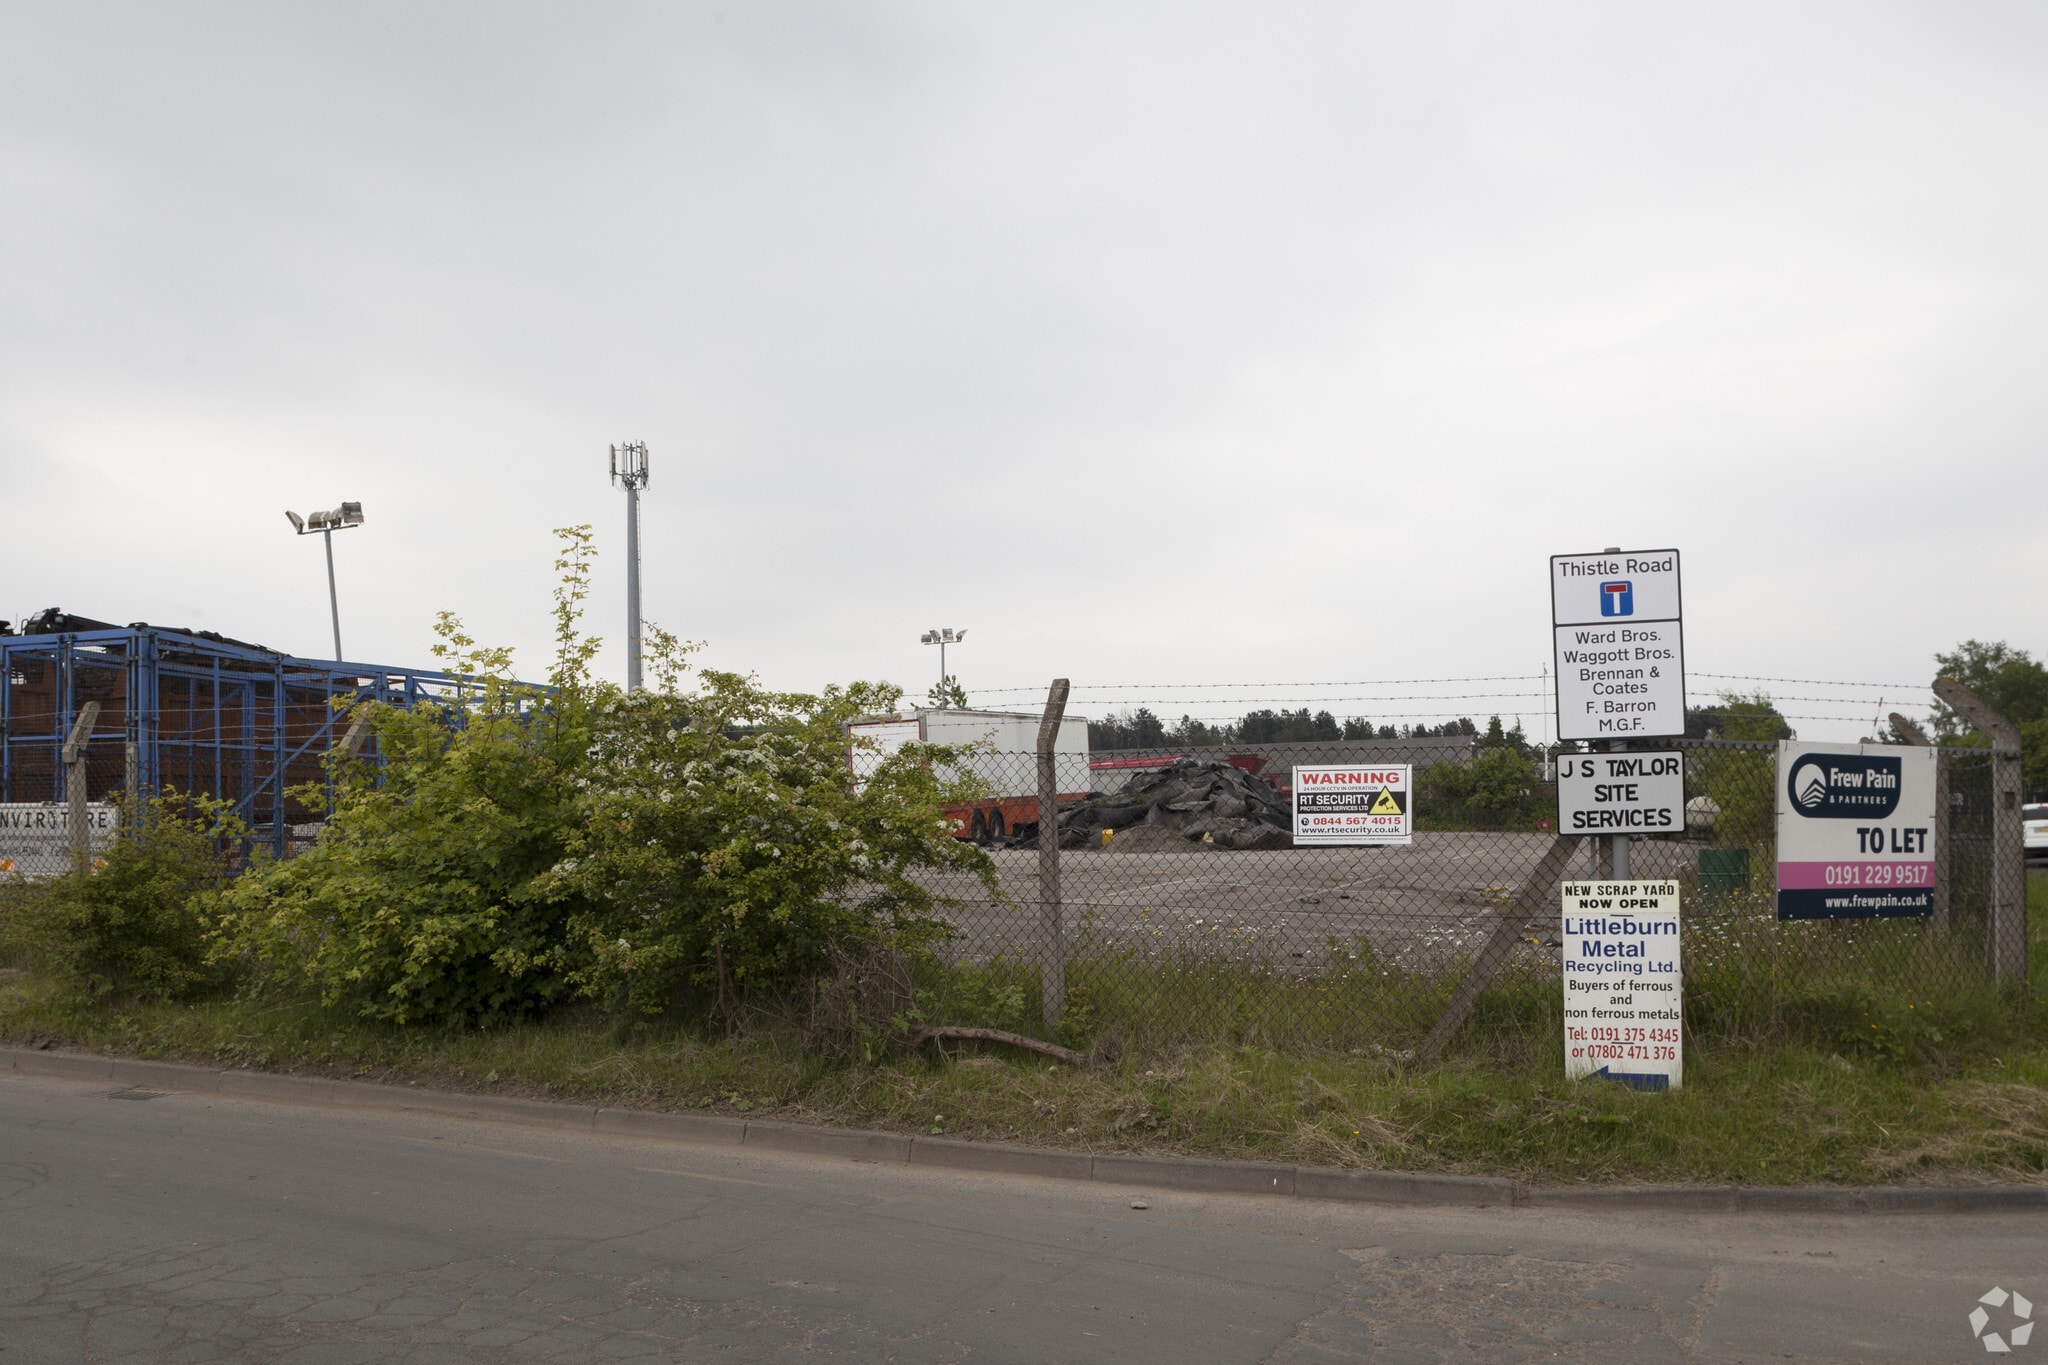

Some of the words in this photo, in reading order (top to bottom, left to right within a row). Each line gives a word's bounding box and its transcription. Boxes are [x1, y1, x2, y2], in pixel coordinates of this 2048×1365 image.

[1560, 560, 1619, 576] Thistle
[1626, 558, 1672, 573] Road
[1576, 631, 1616, 644] Ward
[1622, 630, 1661, 643] Bros.
[1564, 649, 1630, 664] Waggott
[1635, 648, 1674, 660] Bros.
[1580, 668, 1644, 681] Brennan
[1650, 666, 1660, 678] &
[1593, 682, 1648, 695] Coates
[1586, 702, 1598, 714] F.
[1604, 700, 1656, 713] Barron
[1599, 718, 1645, 732] M.G.F.
[1561, 760, 1573, 778] J
[1581, 760, 1594, 778] S
[1606, 758, 1679, 777] TAYLOR
[1302, 772, 1400, 784] WARNING
[1830, 768, 1863, 787] Frew
[1866, 768, 1896, 788] Pain
[1300, 795, 1314, 805] RT
[1316, 794, 1369, 804] SECURITY
[1594, 784, 1639, 802] SITE
[1830, 795, 1834, 803] &
[1838, 796, 1887, 804] PARTNERS
[1572, 808, 1672, 828] SERVICES
[1302, 826, 1400, 834] www.rtsecurity.co.uk
[1856, 827, 1884, 854] TO
[1891, 828, 1928, 853] LET
[1826, 866, 1860, 884] 0191
[1865, 866, 1892, 884] 229
[1896, 865, 1928, 884] 9517
[1565, 886, 1591, 896] NEW
[1597, 885, 1637, 896] SCRAP
[1642, 885, 1675, 895] YARD
[1579, 900, 1613, 908] NOW
[1619, 899, 1658, 908] OPEN
[1825, 894, 1927, 909] www.frewpain.co.uk
[1565, 918, 1677, 935] Littleburn
[1582, 940, 1645, 957] Metal
[1566, 960, 1643, 975] Recycling
[1649, 961, 1678, 973] Ltd.
[1569, 980, 1609, 993] Buyers
[1613, 980, 1626, 991] of
[1629, 980, 1673, 991] ferrous
[1610, 994, 1632, 1005] and
[1565, 1009, 1588, 1018] non
[1592, 1008, 1635, 1019] ferrous
[1638, 1008, 1680, 1020] metals
[1568, 1027, 1588, 1040] Tel:
[1591, 1028, 1620, 1041] 0191
[1624, 1028, 1645, 1041] 375
[1649, 1028, 1678, 1042] 4345
[1572, 1047, 1584, 1058] or
[1588, 1045, 1623, 1059] 07802
[1628, 1046, 1649, 1059] 471
[1653, 1046, 1675, 1060] 376
